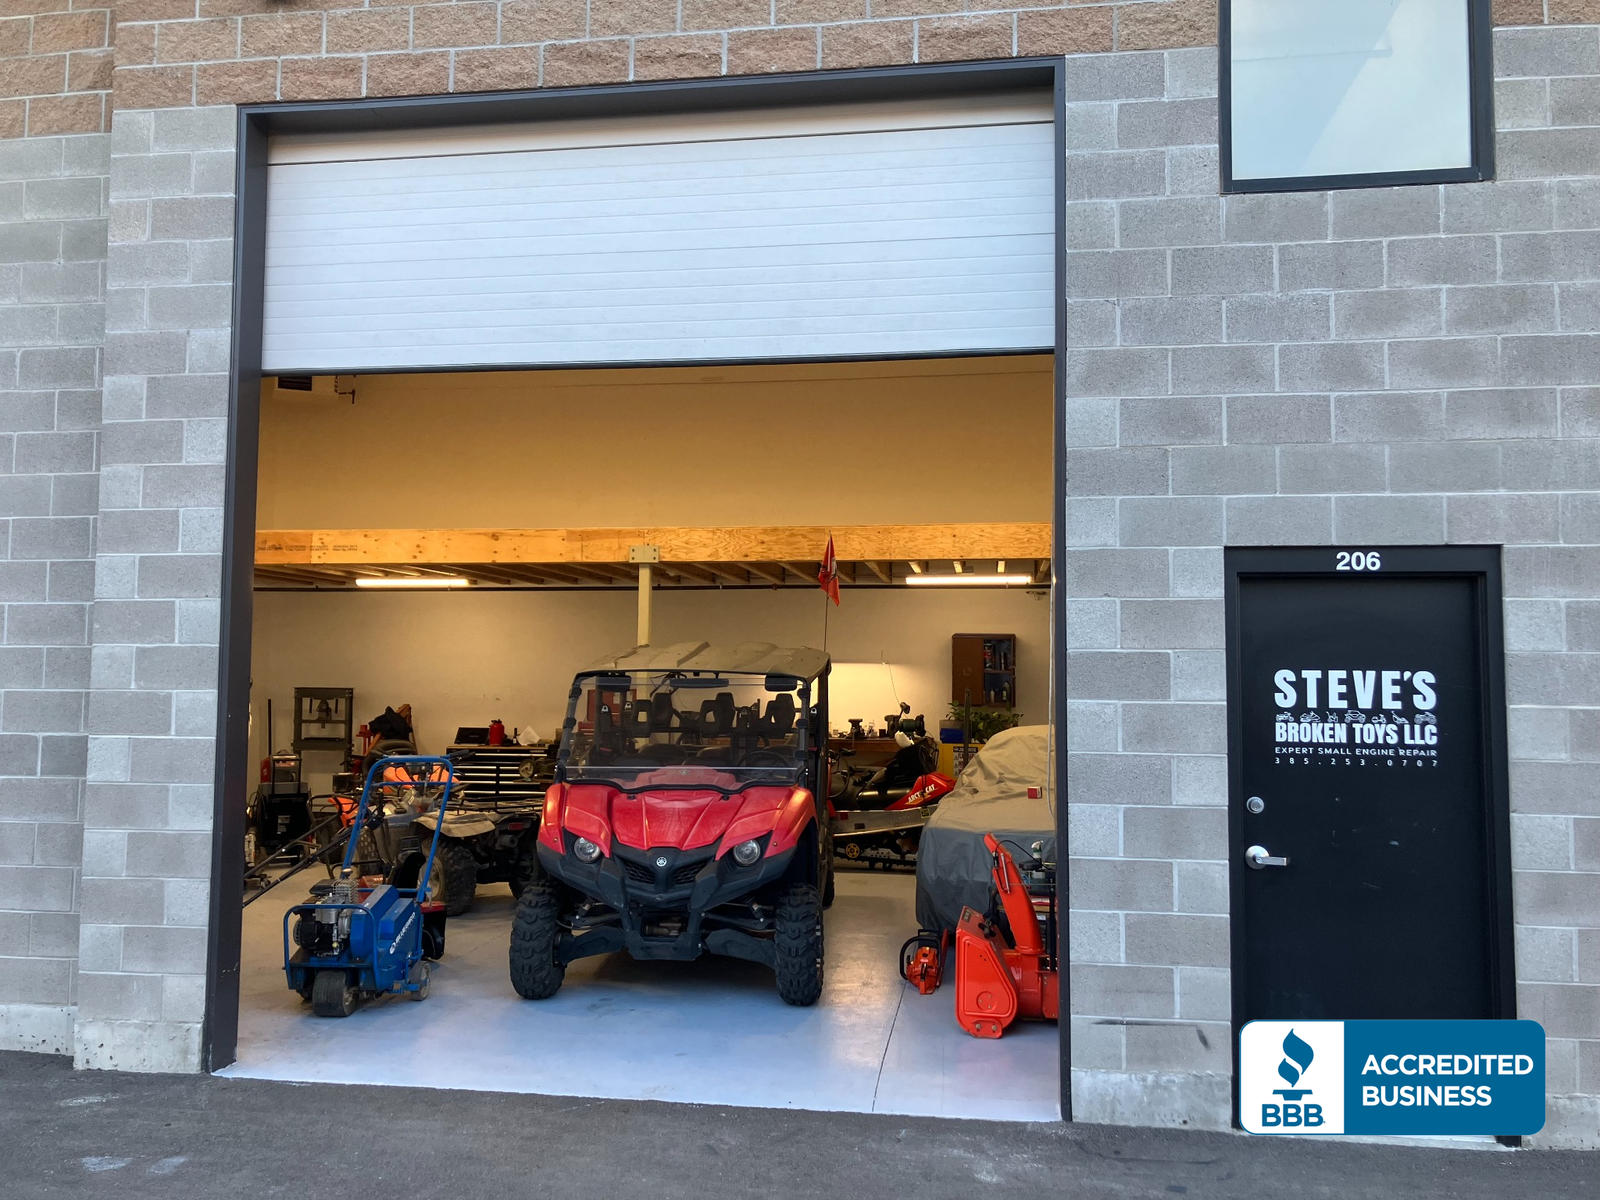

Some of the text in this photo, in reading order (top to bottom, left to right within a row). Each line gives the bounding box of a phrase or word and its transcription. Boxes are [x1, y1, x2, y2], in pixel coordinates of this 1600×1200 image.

[1335, 551, 1381, 571] 206
[1273, 669, 1437, 710] STEVE'S
[1275, 722, 1438, 745] BROKEN TOYS LLC
[1274, 746, 1438, 757] EXPERT SMALL ENGINE REPAIR
[925, 783, 936, 794] CAT
